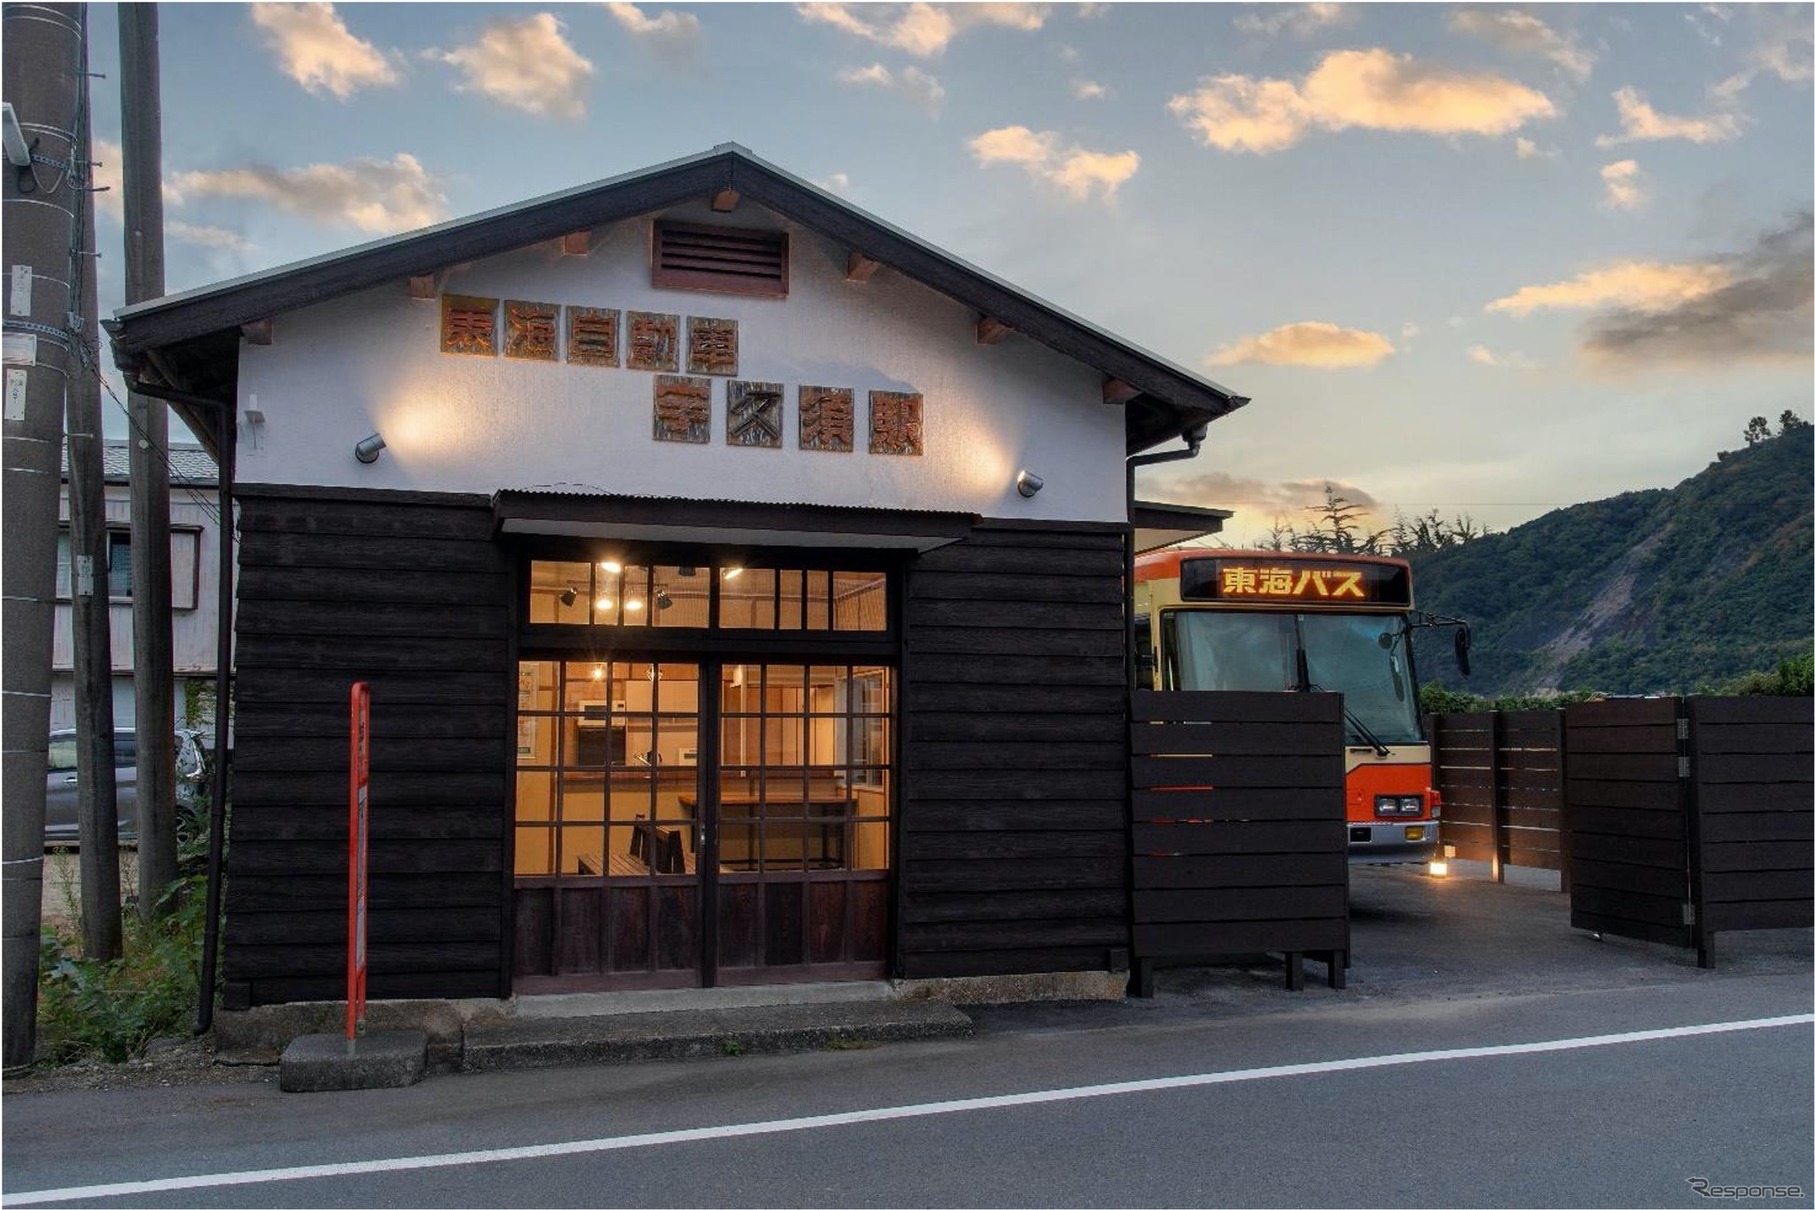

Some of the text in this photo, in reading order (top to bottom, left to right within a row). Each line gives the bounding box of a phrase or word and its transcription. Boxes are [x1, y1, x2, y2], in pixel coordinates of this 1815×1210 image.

[446, 300, 735, 366] 東海自動車
[656, 382, 921, 449] 宇久須駅
[1222, 567, 1366, 598] 東海バス
